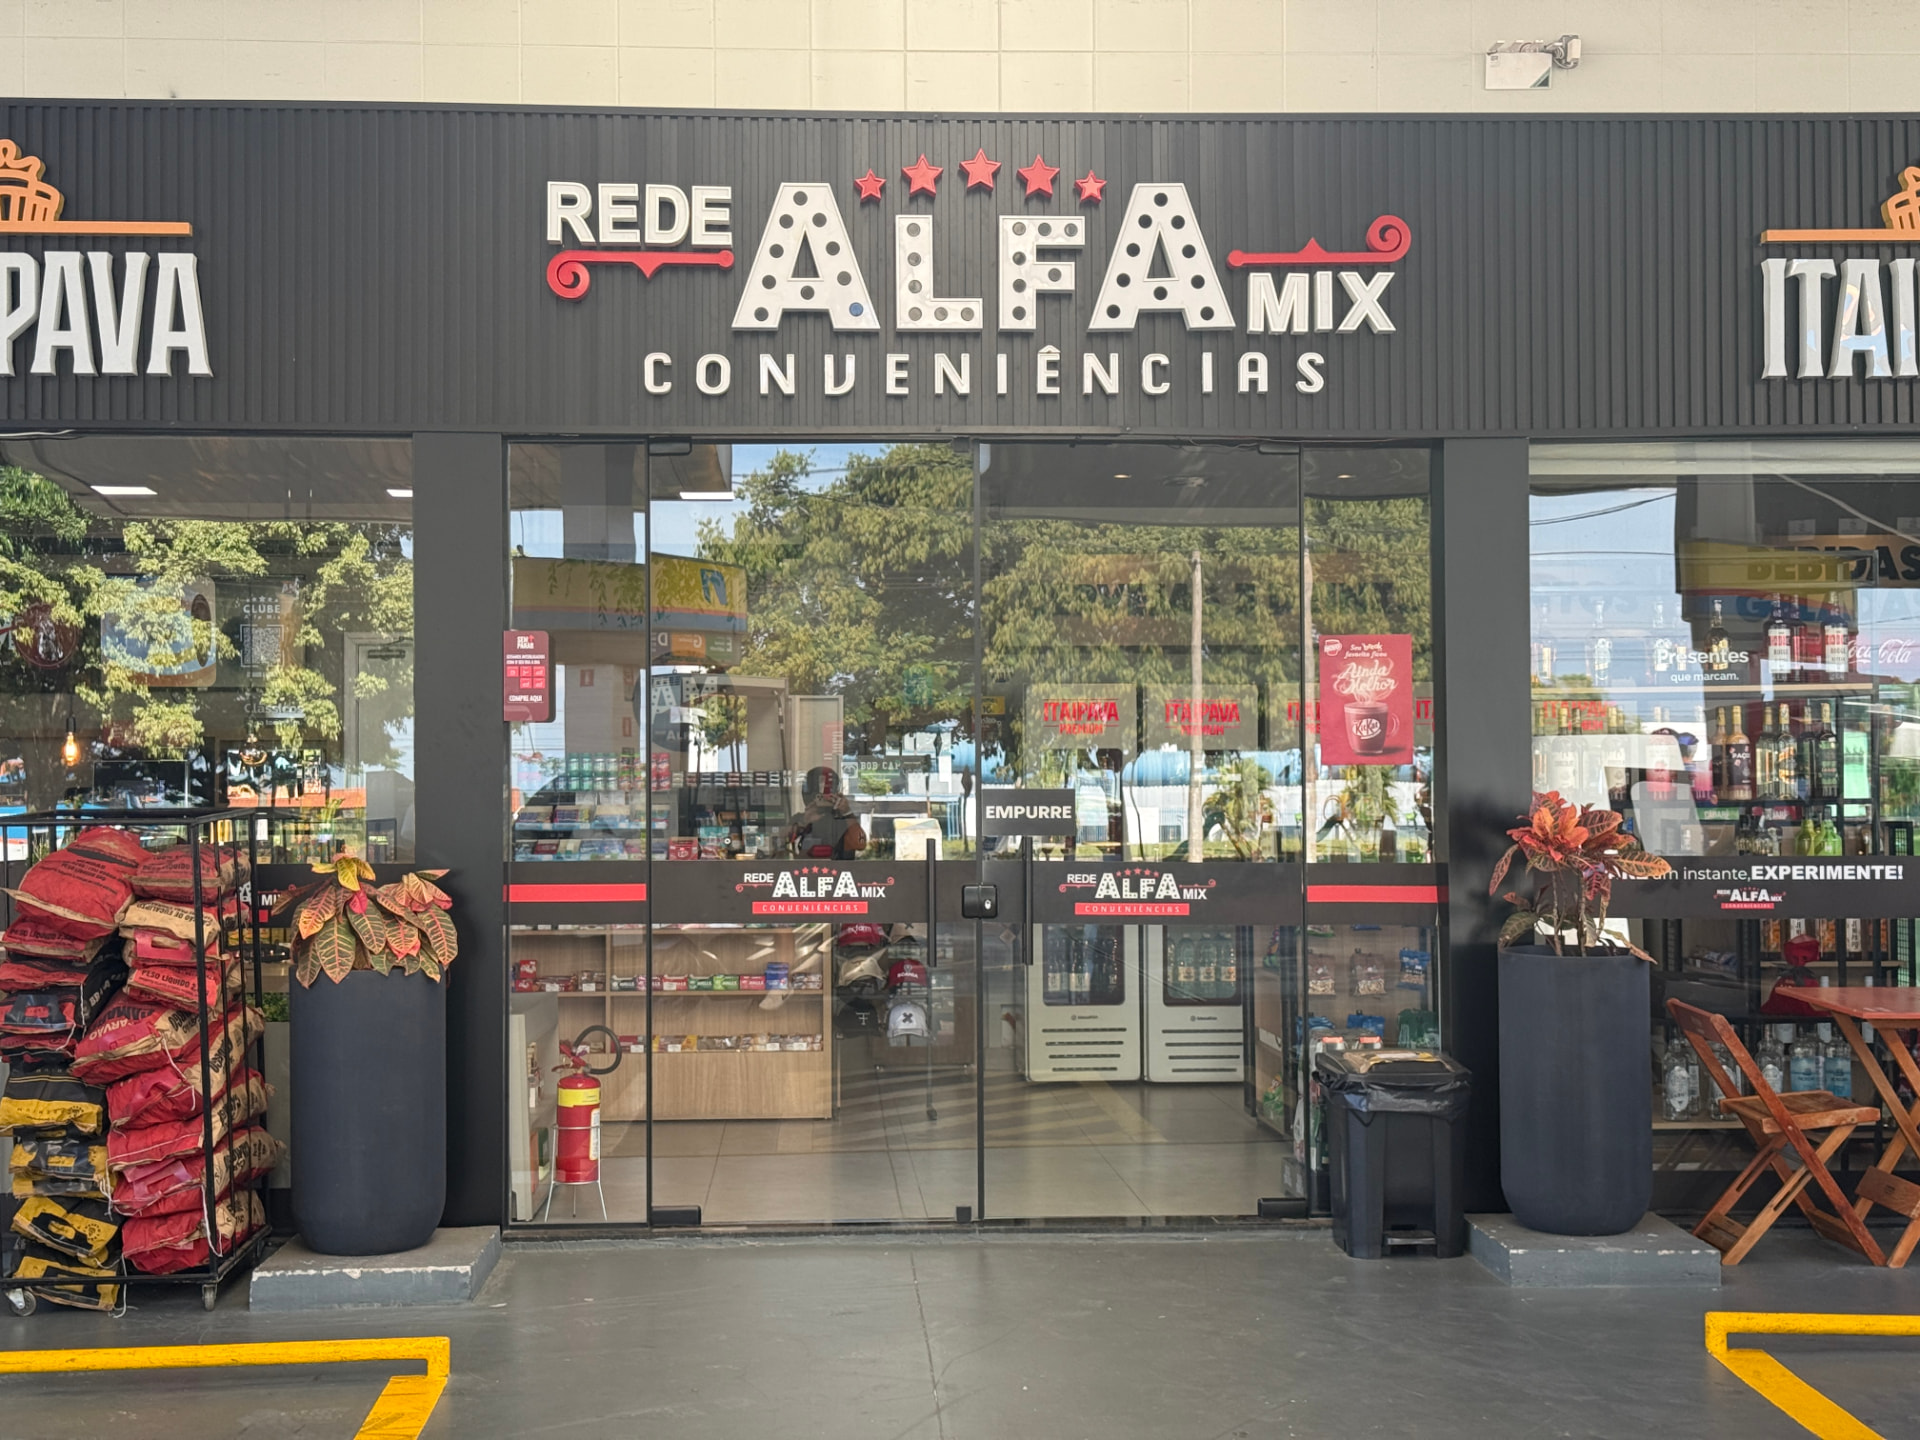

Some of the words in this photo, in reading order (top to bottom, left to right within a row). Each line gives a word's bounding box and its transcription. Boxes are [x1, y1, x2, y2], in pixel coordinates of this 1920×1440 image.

[546, 181, 734, 248] REDE
[731, 182, 1236, 333] ALFA
[1245, 271, 1397, 335] MIX
[1761, 258, 1920, 379] ITAI
[642, 344, 1326, 396] CONVENIÊNCIAS
[243, 604, 281, 614] CLUBE
[1657, 649, 1750, 665] Presentes
[1337, 659, 1390, 679] Ainda
[1670, 672, 1691, 683] que
[1693, 672, 1740, 682] marcam.
[1043, 701, 1120, 722] ITAIPAVA
[1164, 702, 1240, 723] ITAIPAVA
[1059, 724, 1105, 735] PREMIUM
[985, 805, 1072, 820] EMPURRE
[1751, 865, 1904, 881] EXPERIMENTE!
[743, 873, 774, 883] REDE
[772, 871, 859, 898] ALFA
[861, 886, 886, 898] MIX
[1067, 874, 1097, 884] REDE
[1095, 872, 1181, 899] ALFA
[1183, 888, 1207, 900] MIX
[261, 894, 281, 906] MI
[1729, 888, 1770, 902] ALFA
[89, 1018, 134, 1041] ARVÃO
